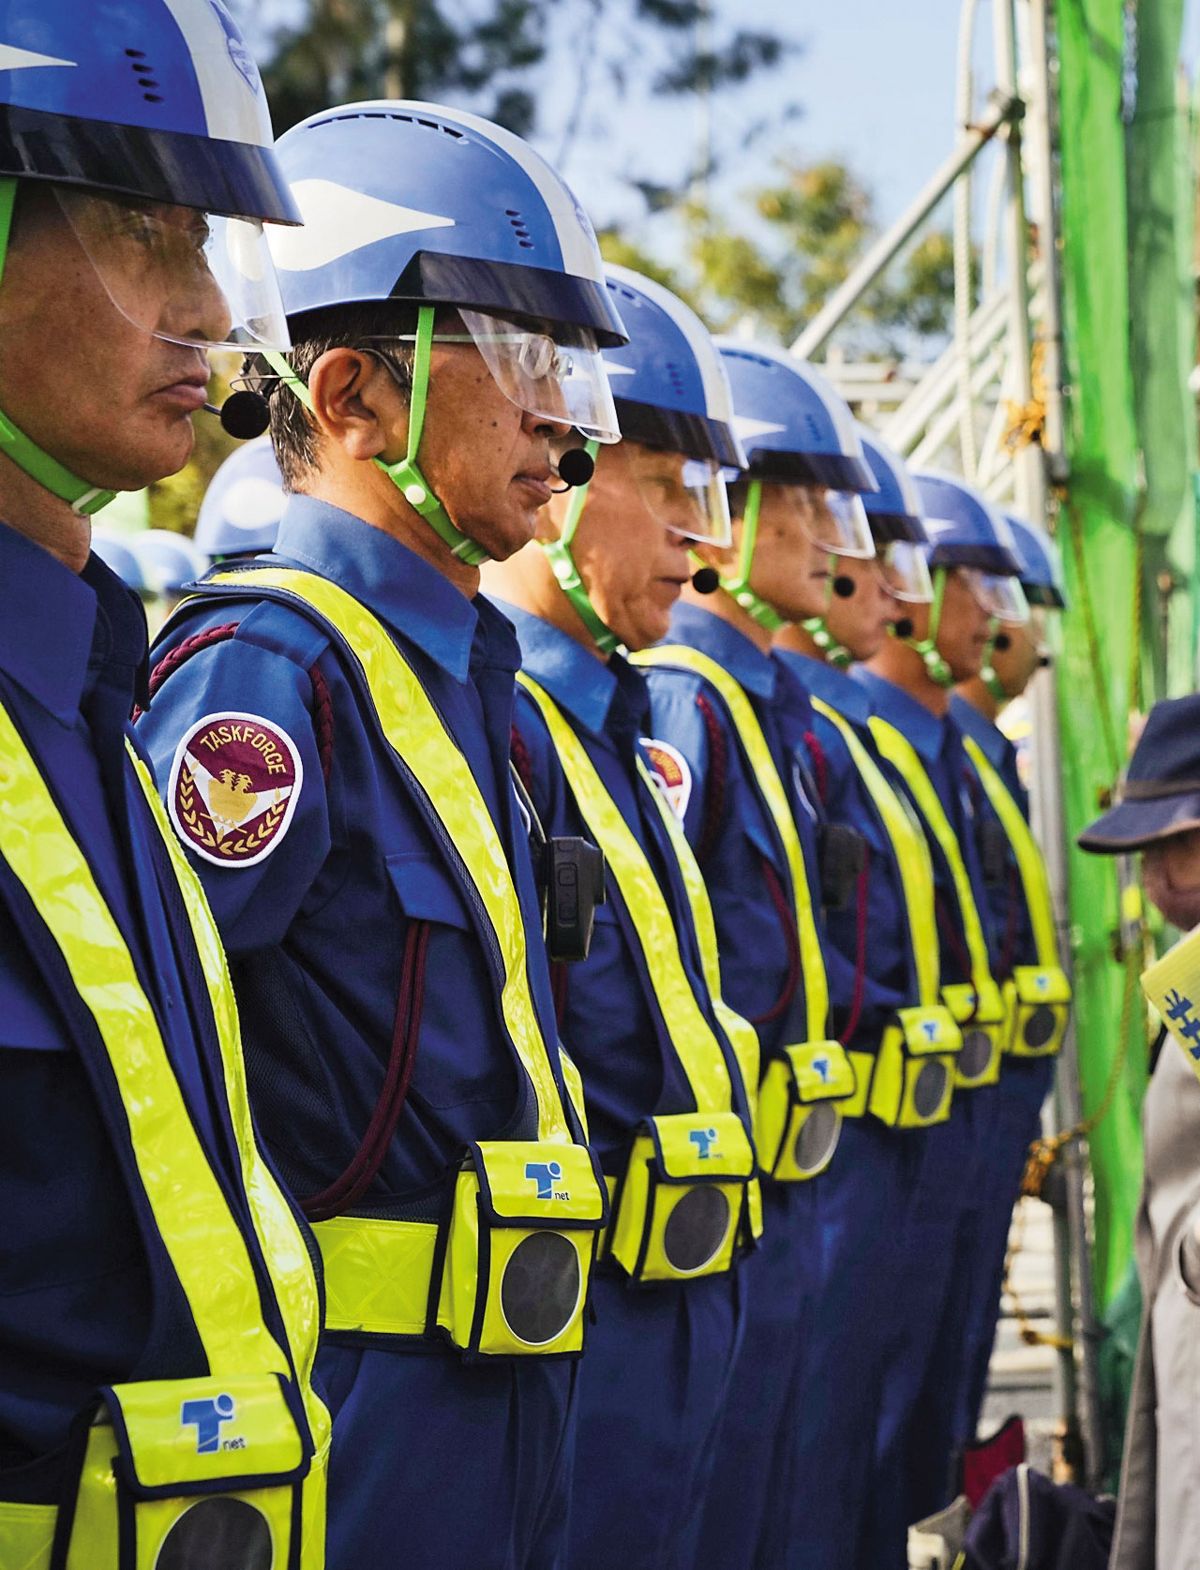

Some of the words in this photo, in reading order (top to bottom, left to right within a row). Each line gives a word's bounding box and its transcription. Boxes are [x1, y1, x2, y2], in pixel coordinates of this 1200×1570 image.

[200, 725, 287, 775] TASKFORCE
[554, 1191, 570, 1201] net
[223, 1437, 246, 1451] net
